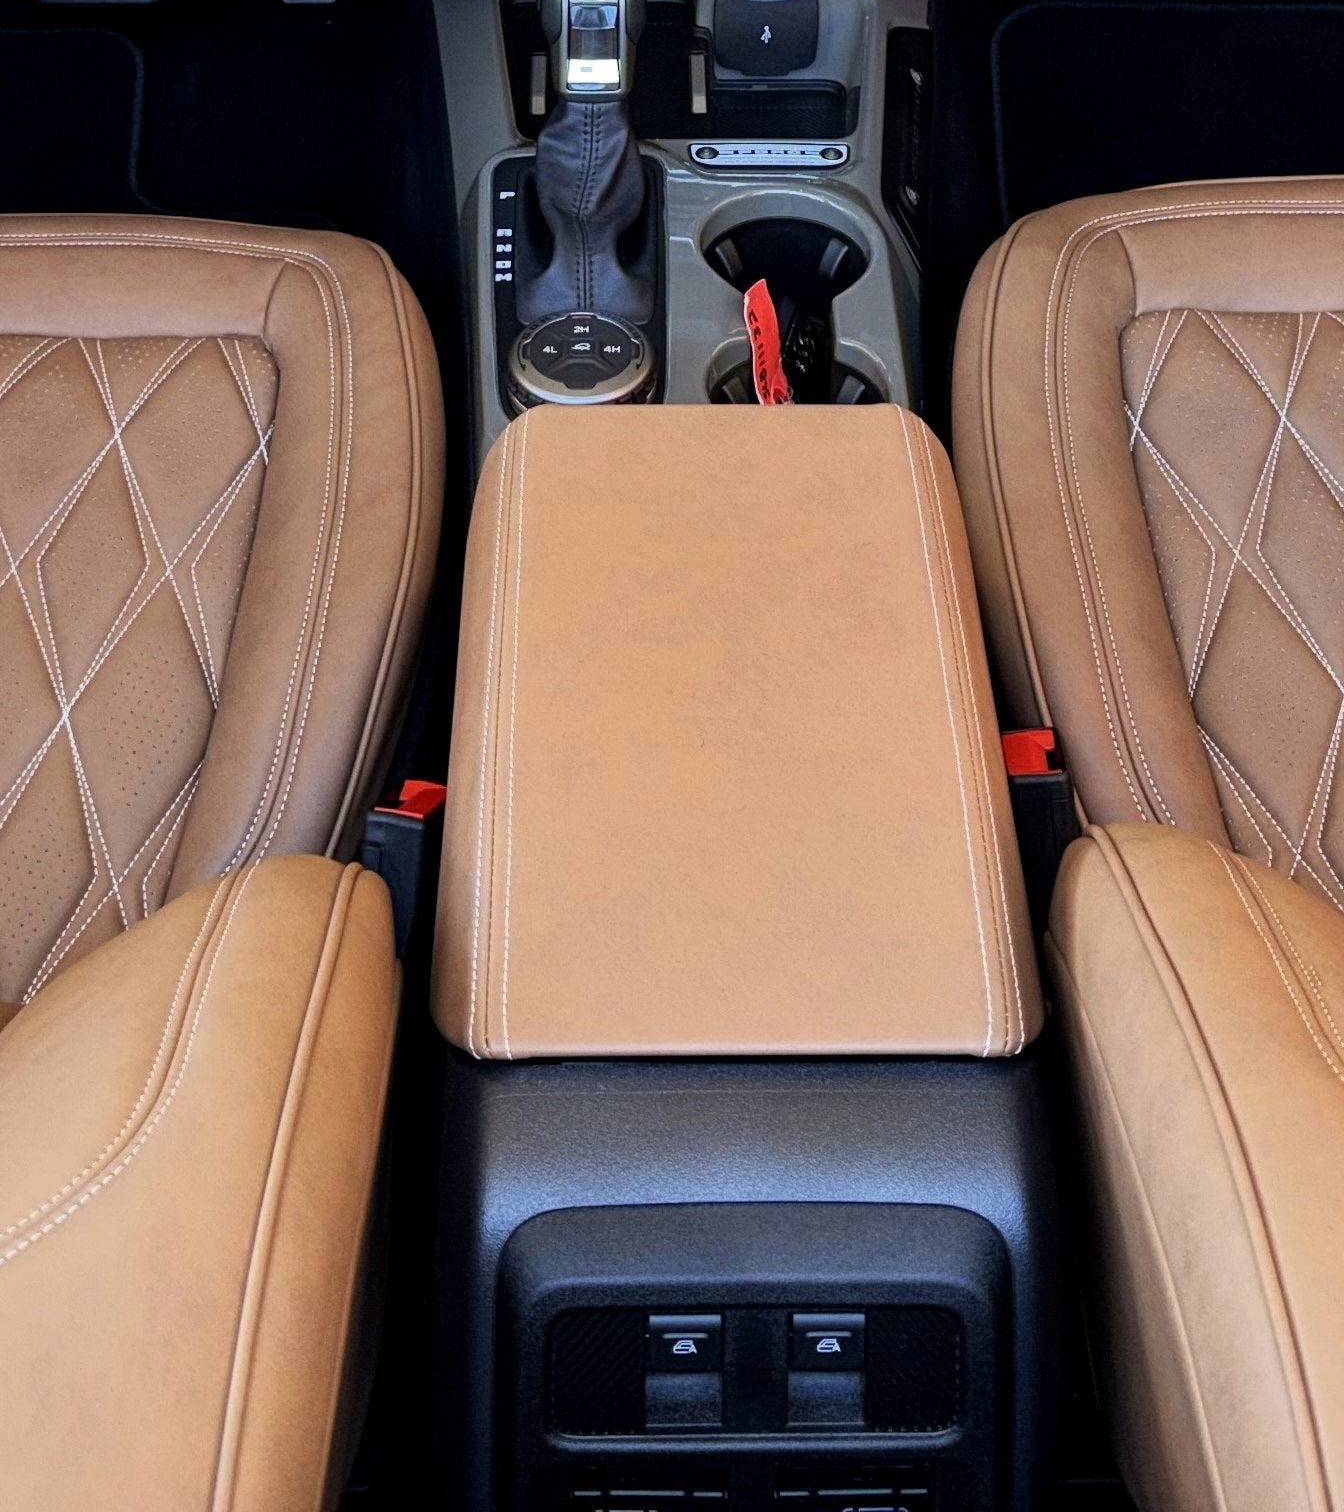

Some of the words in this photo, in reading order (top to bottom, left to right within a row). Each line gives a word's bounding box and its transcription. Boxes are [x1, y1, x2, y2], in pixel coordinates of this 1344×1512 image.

[496, 228, 512, 237] R
[496, 244, 512, 252] N
[495, 260, 512, 268] D
[495, 273, 512, 282] M
[573, 325, 590, 334] 2H
[542, 345, 558, 353] 4L
[603, 345, 621, 353] 4H
